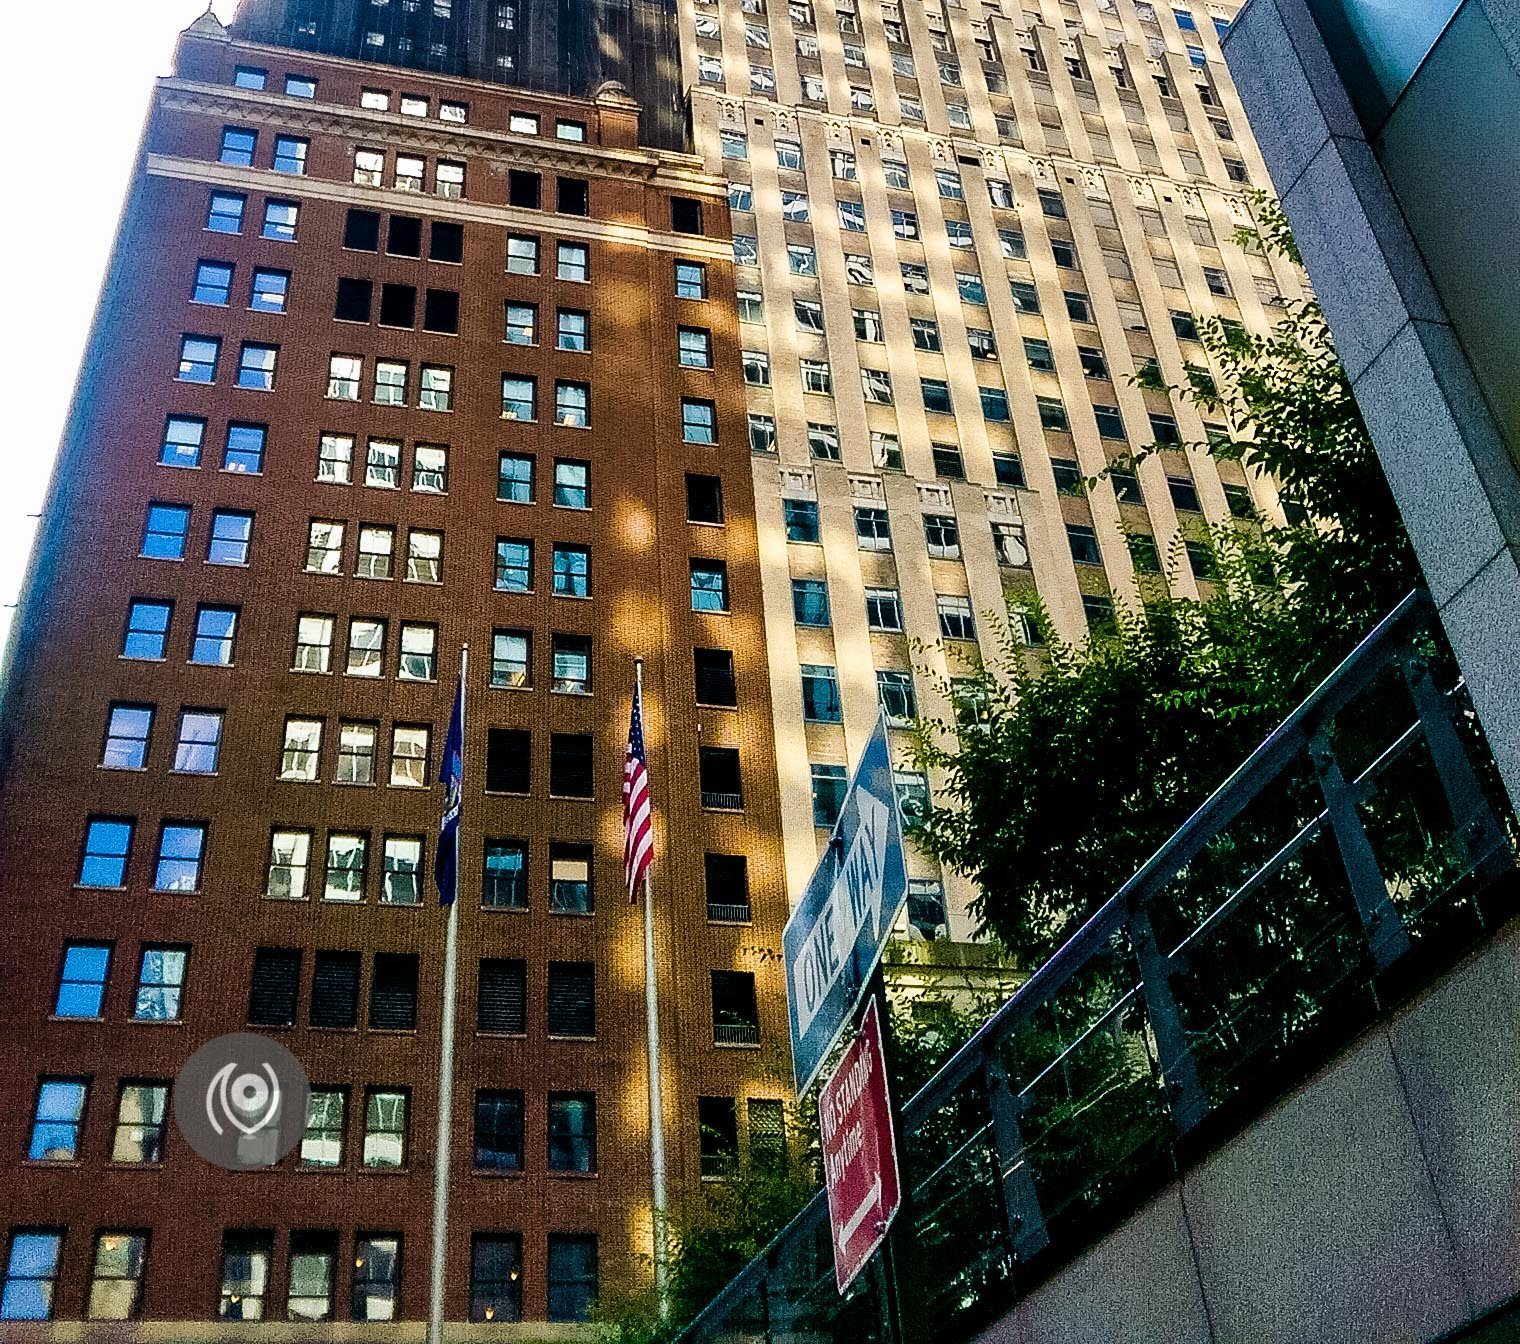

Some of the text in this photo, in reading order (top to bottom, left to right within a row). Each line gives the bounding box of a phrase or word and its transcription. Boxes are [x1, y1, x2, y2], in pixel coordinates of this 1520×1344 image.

[804, 804, 879, 1012] ONE WAY
[823, 1040, 873, 1145] NO STANDING
[830, 1121, 863, 1189] Anytime
